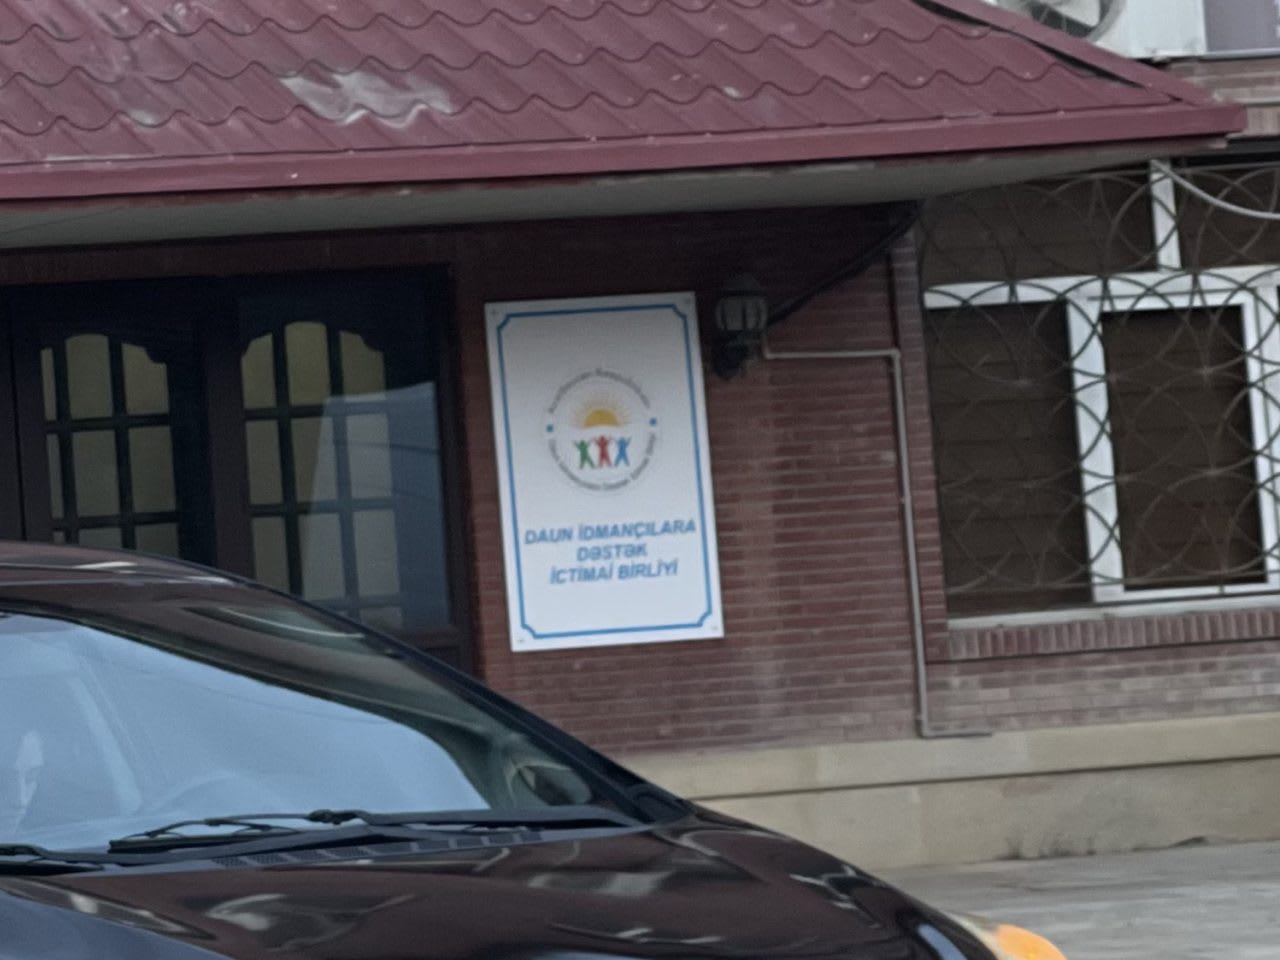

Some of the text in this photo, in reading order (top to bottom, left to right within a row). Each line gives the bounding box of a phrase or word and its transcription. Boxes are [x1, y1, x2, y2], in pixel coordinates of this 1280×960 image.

[524, 519, 697, 545] DAUN İDMANÇILARA
[576, 543, 648, 562] DƏSTƏK
[617, 558, 680, 580] BİRLİYİ
